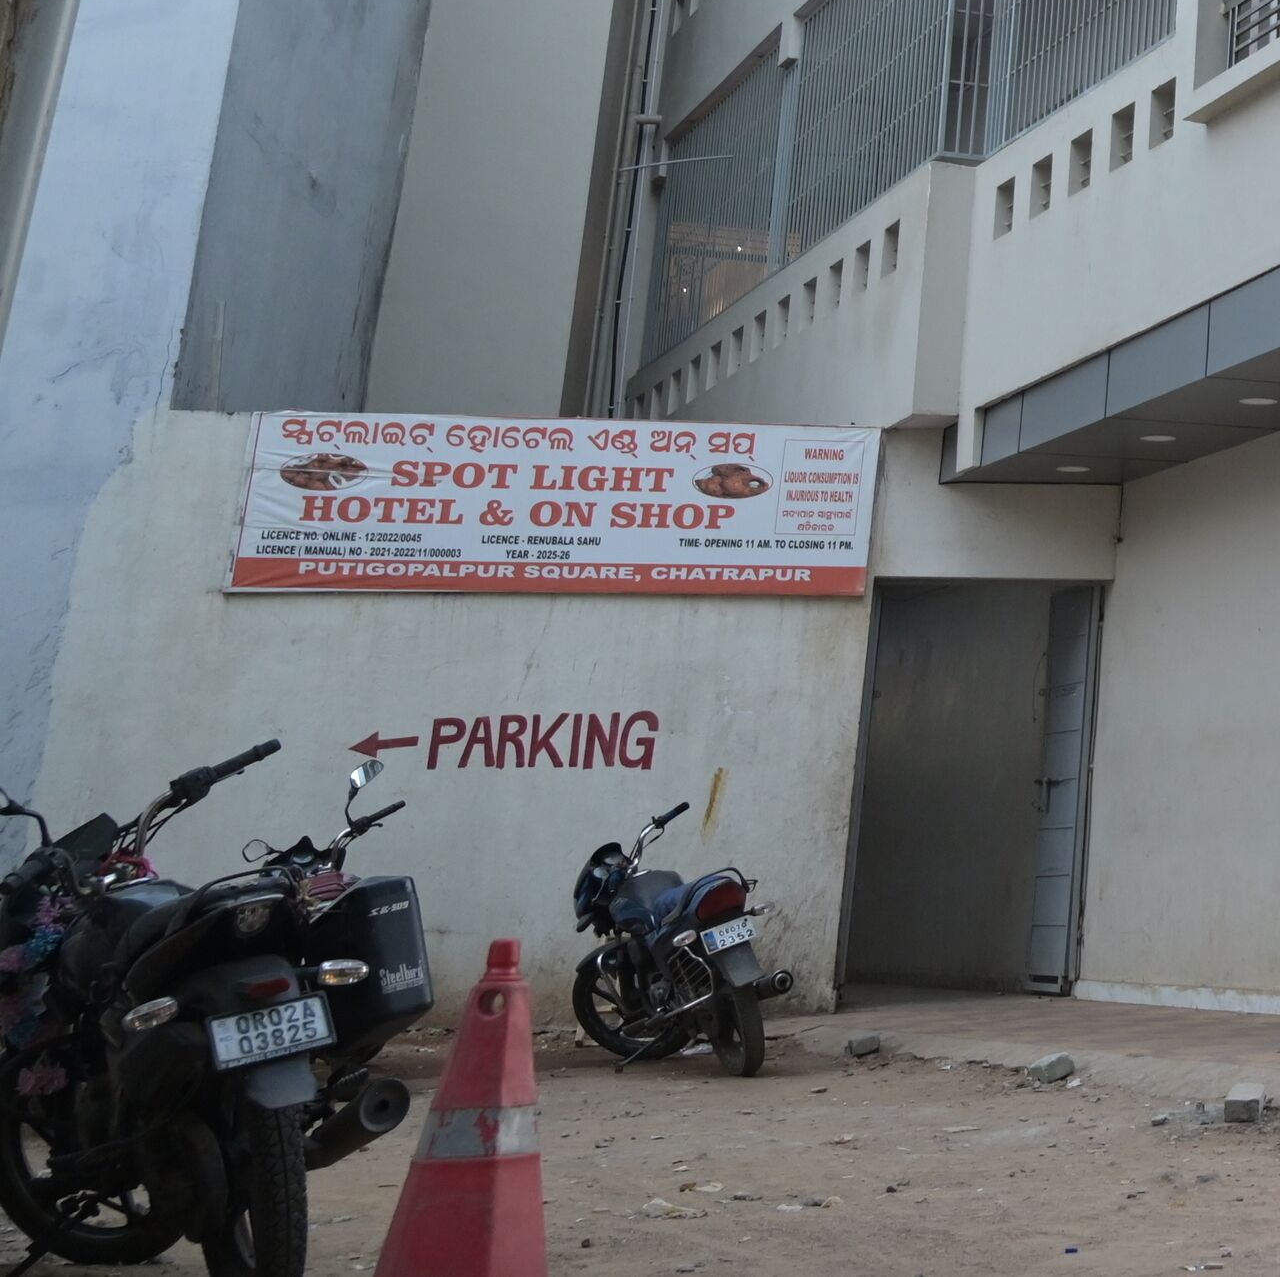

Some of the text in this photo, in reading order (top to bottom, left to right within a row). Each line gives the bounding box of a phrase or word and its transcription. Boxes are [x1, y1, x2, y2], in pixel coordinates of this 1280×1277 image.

[446, 422, 574, 453] ହୋଟେଲ
[804, 448, 845, 461] WARNING
[391, 460, 675, 492] SPOT LIGHT
[784, 471, 859, 485] LIQUOR CONSUMPTION IS
[786, 490, 854, 503] INJURIOUS TO HEALTH
[299, 495, 736, 529] HOTEL & ON SHOP
[261, 530, 301, 540] LICENCE
[303, 531, 319, 541] NO.
[322, 532, 357, 542] ONLINE
[364, 533, 422, 543] 12/2022/0045
[481, 535, 520, 545] LICENCE
[527, 535, 574, 546] RENUBALA
[577, 536, 602, 546] SAHU
[256, 545, 297, 555] LICENCE
[349, 547, 362, 556] NO
[678, 538, 854, 550] TIME- OPENING 11 AM. TO CLOSING 11 PM.
[505, 549, 529, 559] YEAR
[536, 550, 571, 560] 2025-26
[299, 561, 811, 582] PUTIGOPALPUR SQUARE, CHATRAPUR
[427, 710, 659, 770] PARKING
[719, 929, 754, 947] 2352
